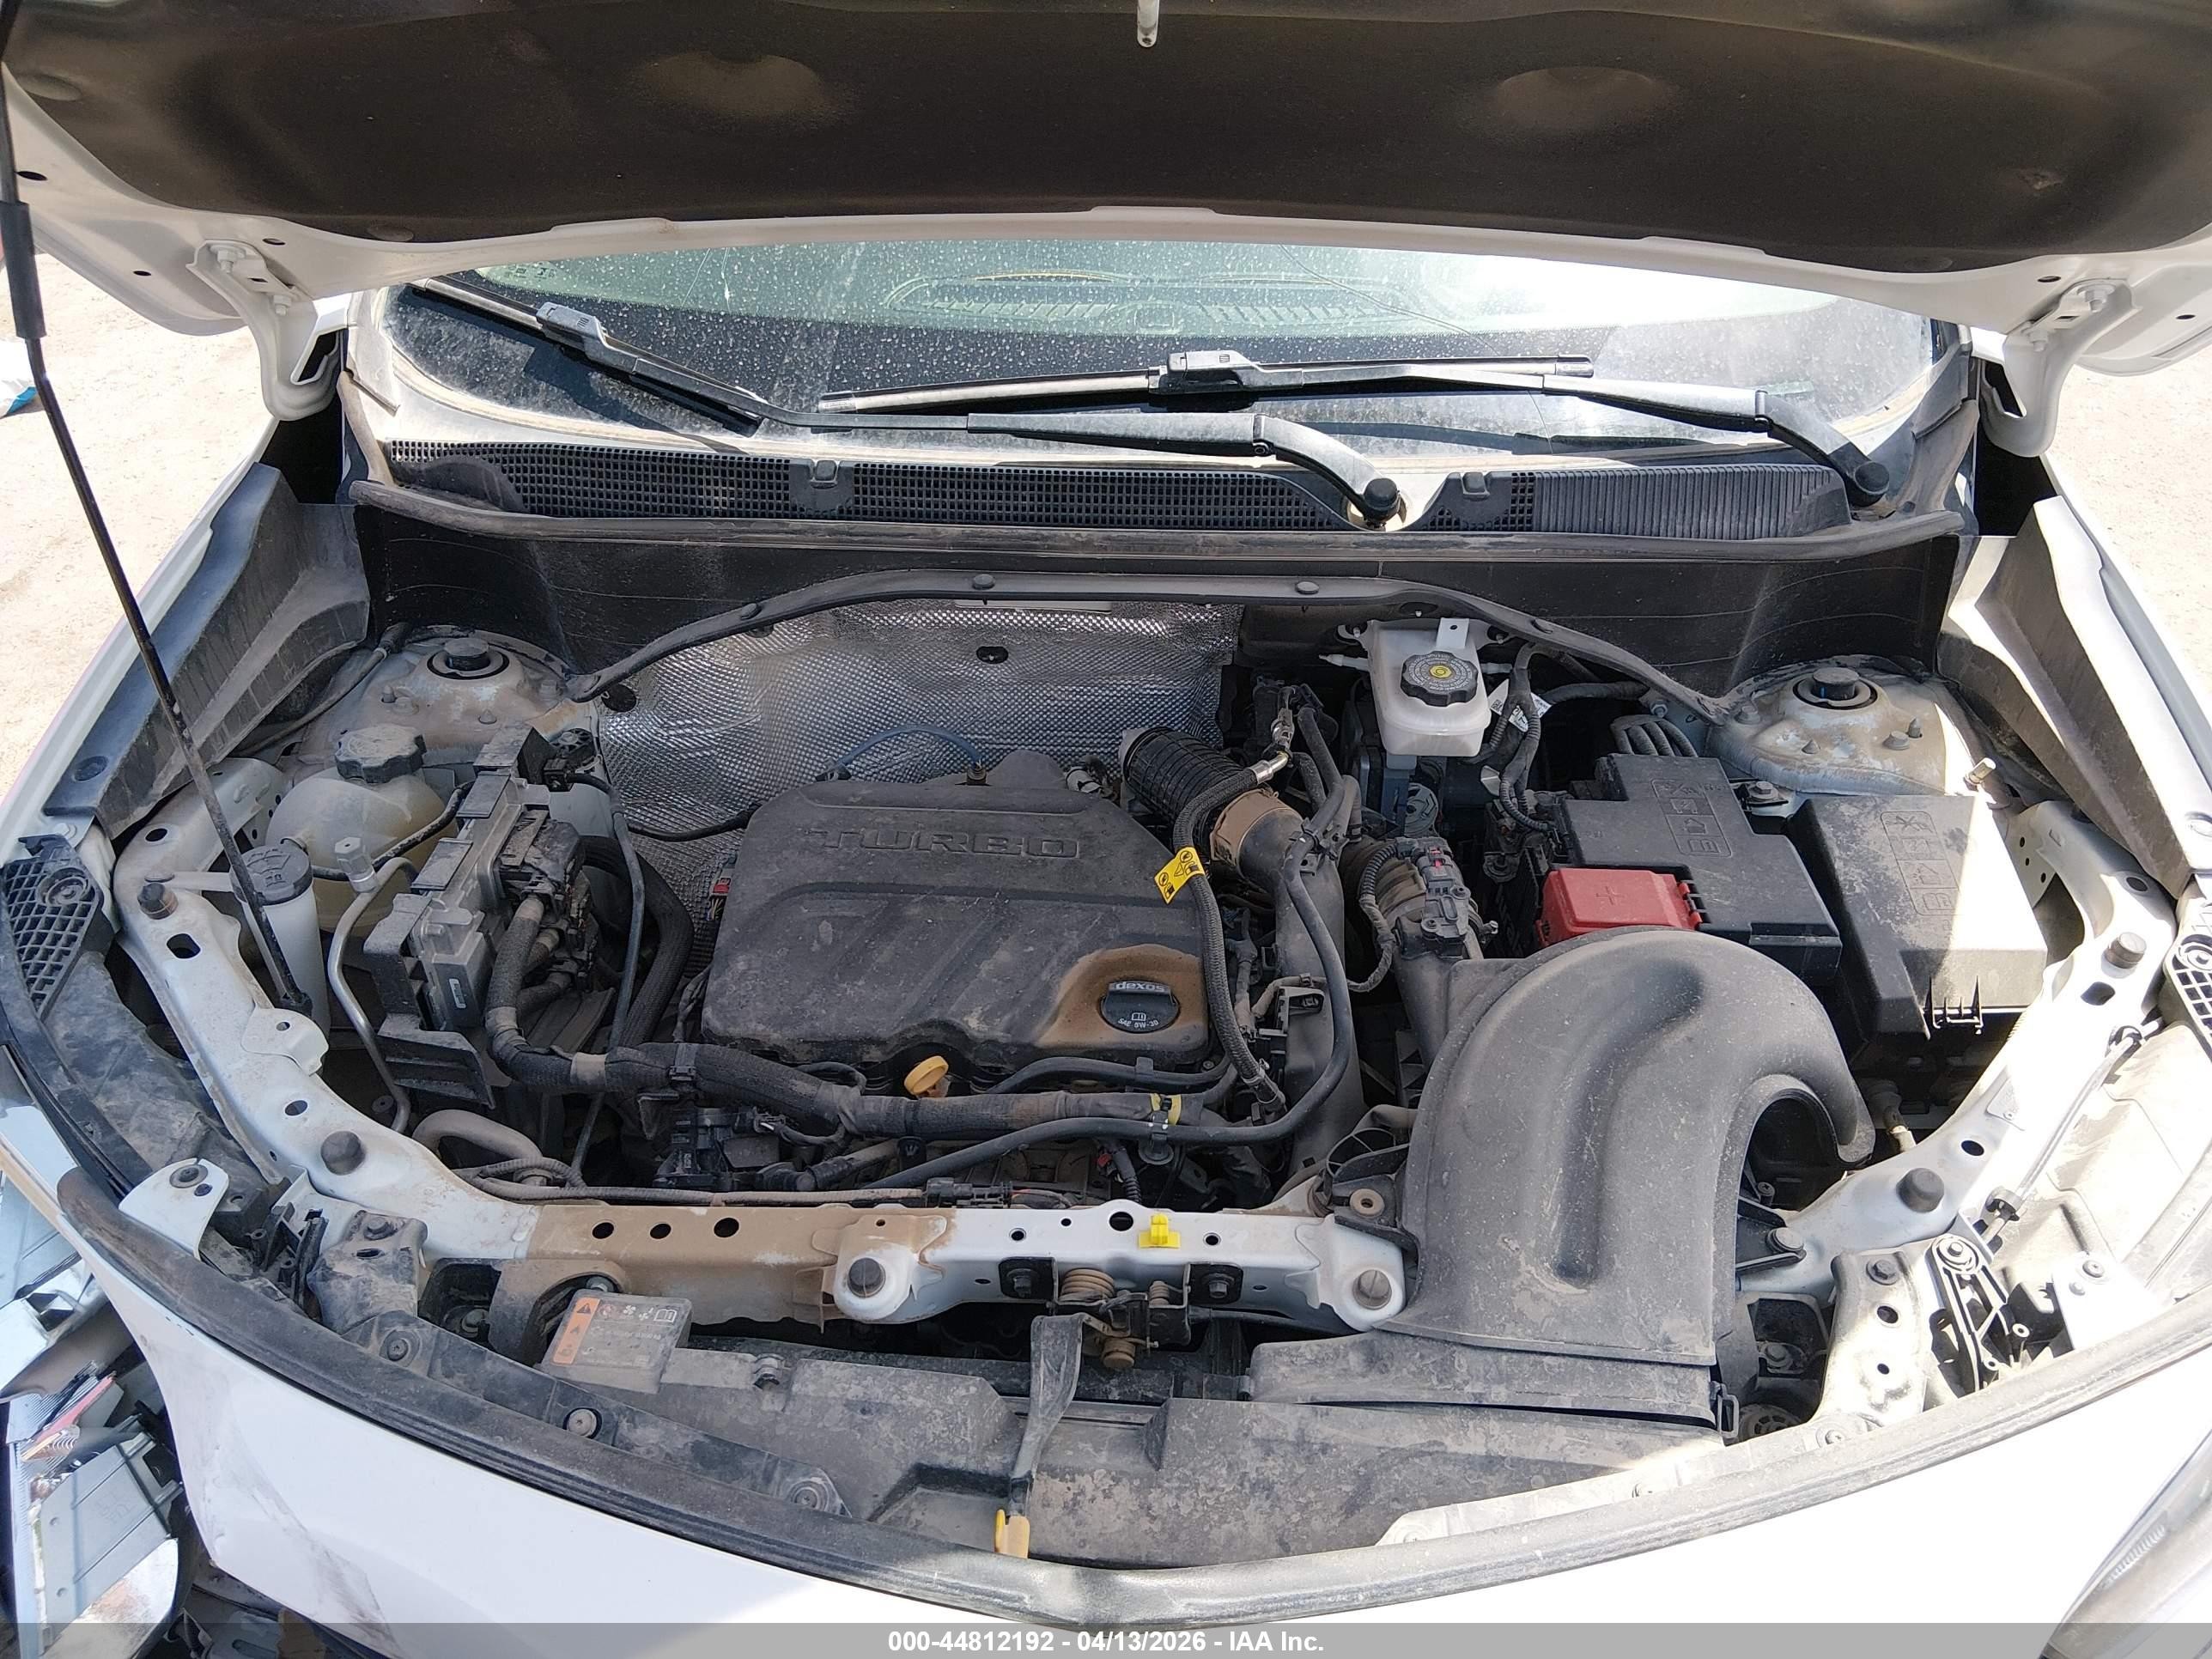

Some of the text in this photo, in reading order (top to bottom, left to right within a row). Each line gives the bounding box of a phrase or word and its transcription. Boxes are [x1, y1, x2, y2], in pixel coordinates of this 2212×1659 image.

[808, 830, 1079, 859] TURBO
[1115, 981, 1164, 993] dexos
[1117, 1018, 1132, 1027] SAE
